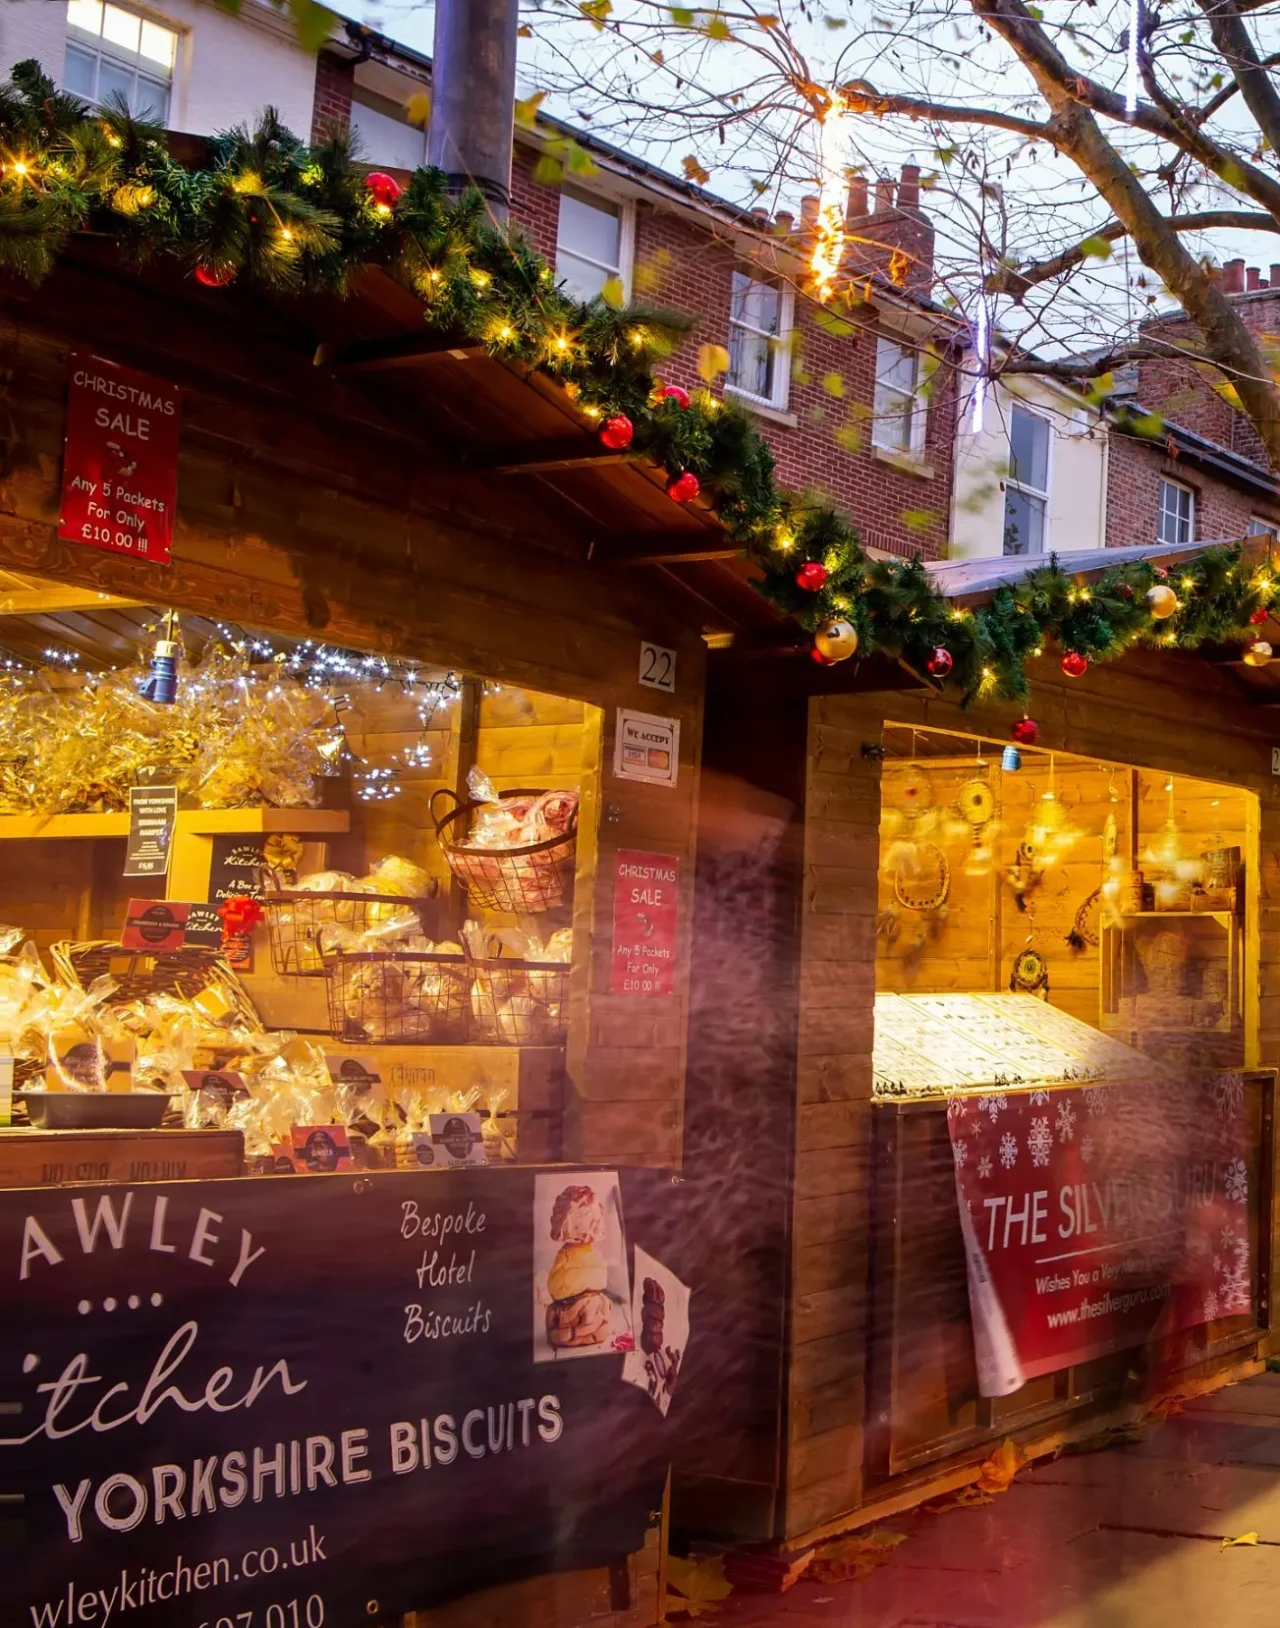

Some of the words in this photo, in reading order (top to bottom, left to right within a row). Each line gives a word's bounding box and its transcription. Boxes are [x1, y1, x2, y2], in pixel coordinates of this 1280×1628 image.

[73, 370, 175, 416] CHRISTMAS
[94, 407, 150, 441] SALE
[71, 475, 97, 497] Any
[102, 482, 111, 496] 5
[116, 486, 165, 513] Packets
[87, 501, 110, 520] For
[116, 510, 145, 533] Only
[81, 523, 133, 548] £10.00
[137, 536, 148, 552] !!!
[641, 646, 672, 687] 22
[627, 727, 638, 739] WE
[640, 731, 669, 745] ACCEPT
[231, 845, 260, 854] SAWLE
[618, 863, 676, 882] CHRISTMAS
[630, 888, 662, 906] SALE
[617, 944, 631, 958] Any
[642, 945, 670, 959] Packets
[626, 961, 640, 974] For
[642, 961, 659, 977] Only
[400, 1200, 487, 1246] Bespoke
[983, 1190, 1048, 1251] THE
[19, 1191, 266, 1288] AWLEY
[416, 1250, 475, 1289] Hotel
[1035, 1274, 1071, 1295] Wishes
[1072, 1268, 1090, 1289] You
[1092, 1270, 1099, 1282] a
[1101, 1262, 1121, 1282] Very
[403, 1300, 492, 1344] Biscuits
[53, 1428, 372, 1543] YORKSHIRE
[390, 1394, 563, 1476] BISCUITS
[29, 1524, 328, 1628] wleykitchen.co.uk
